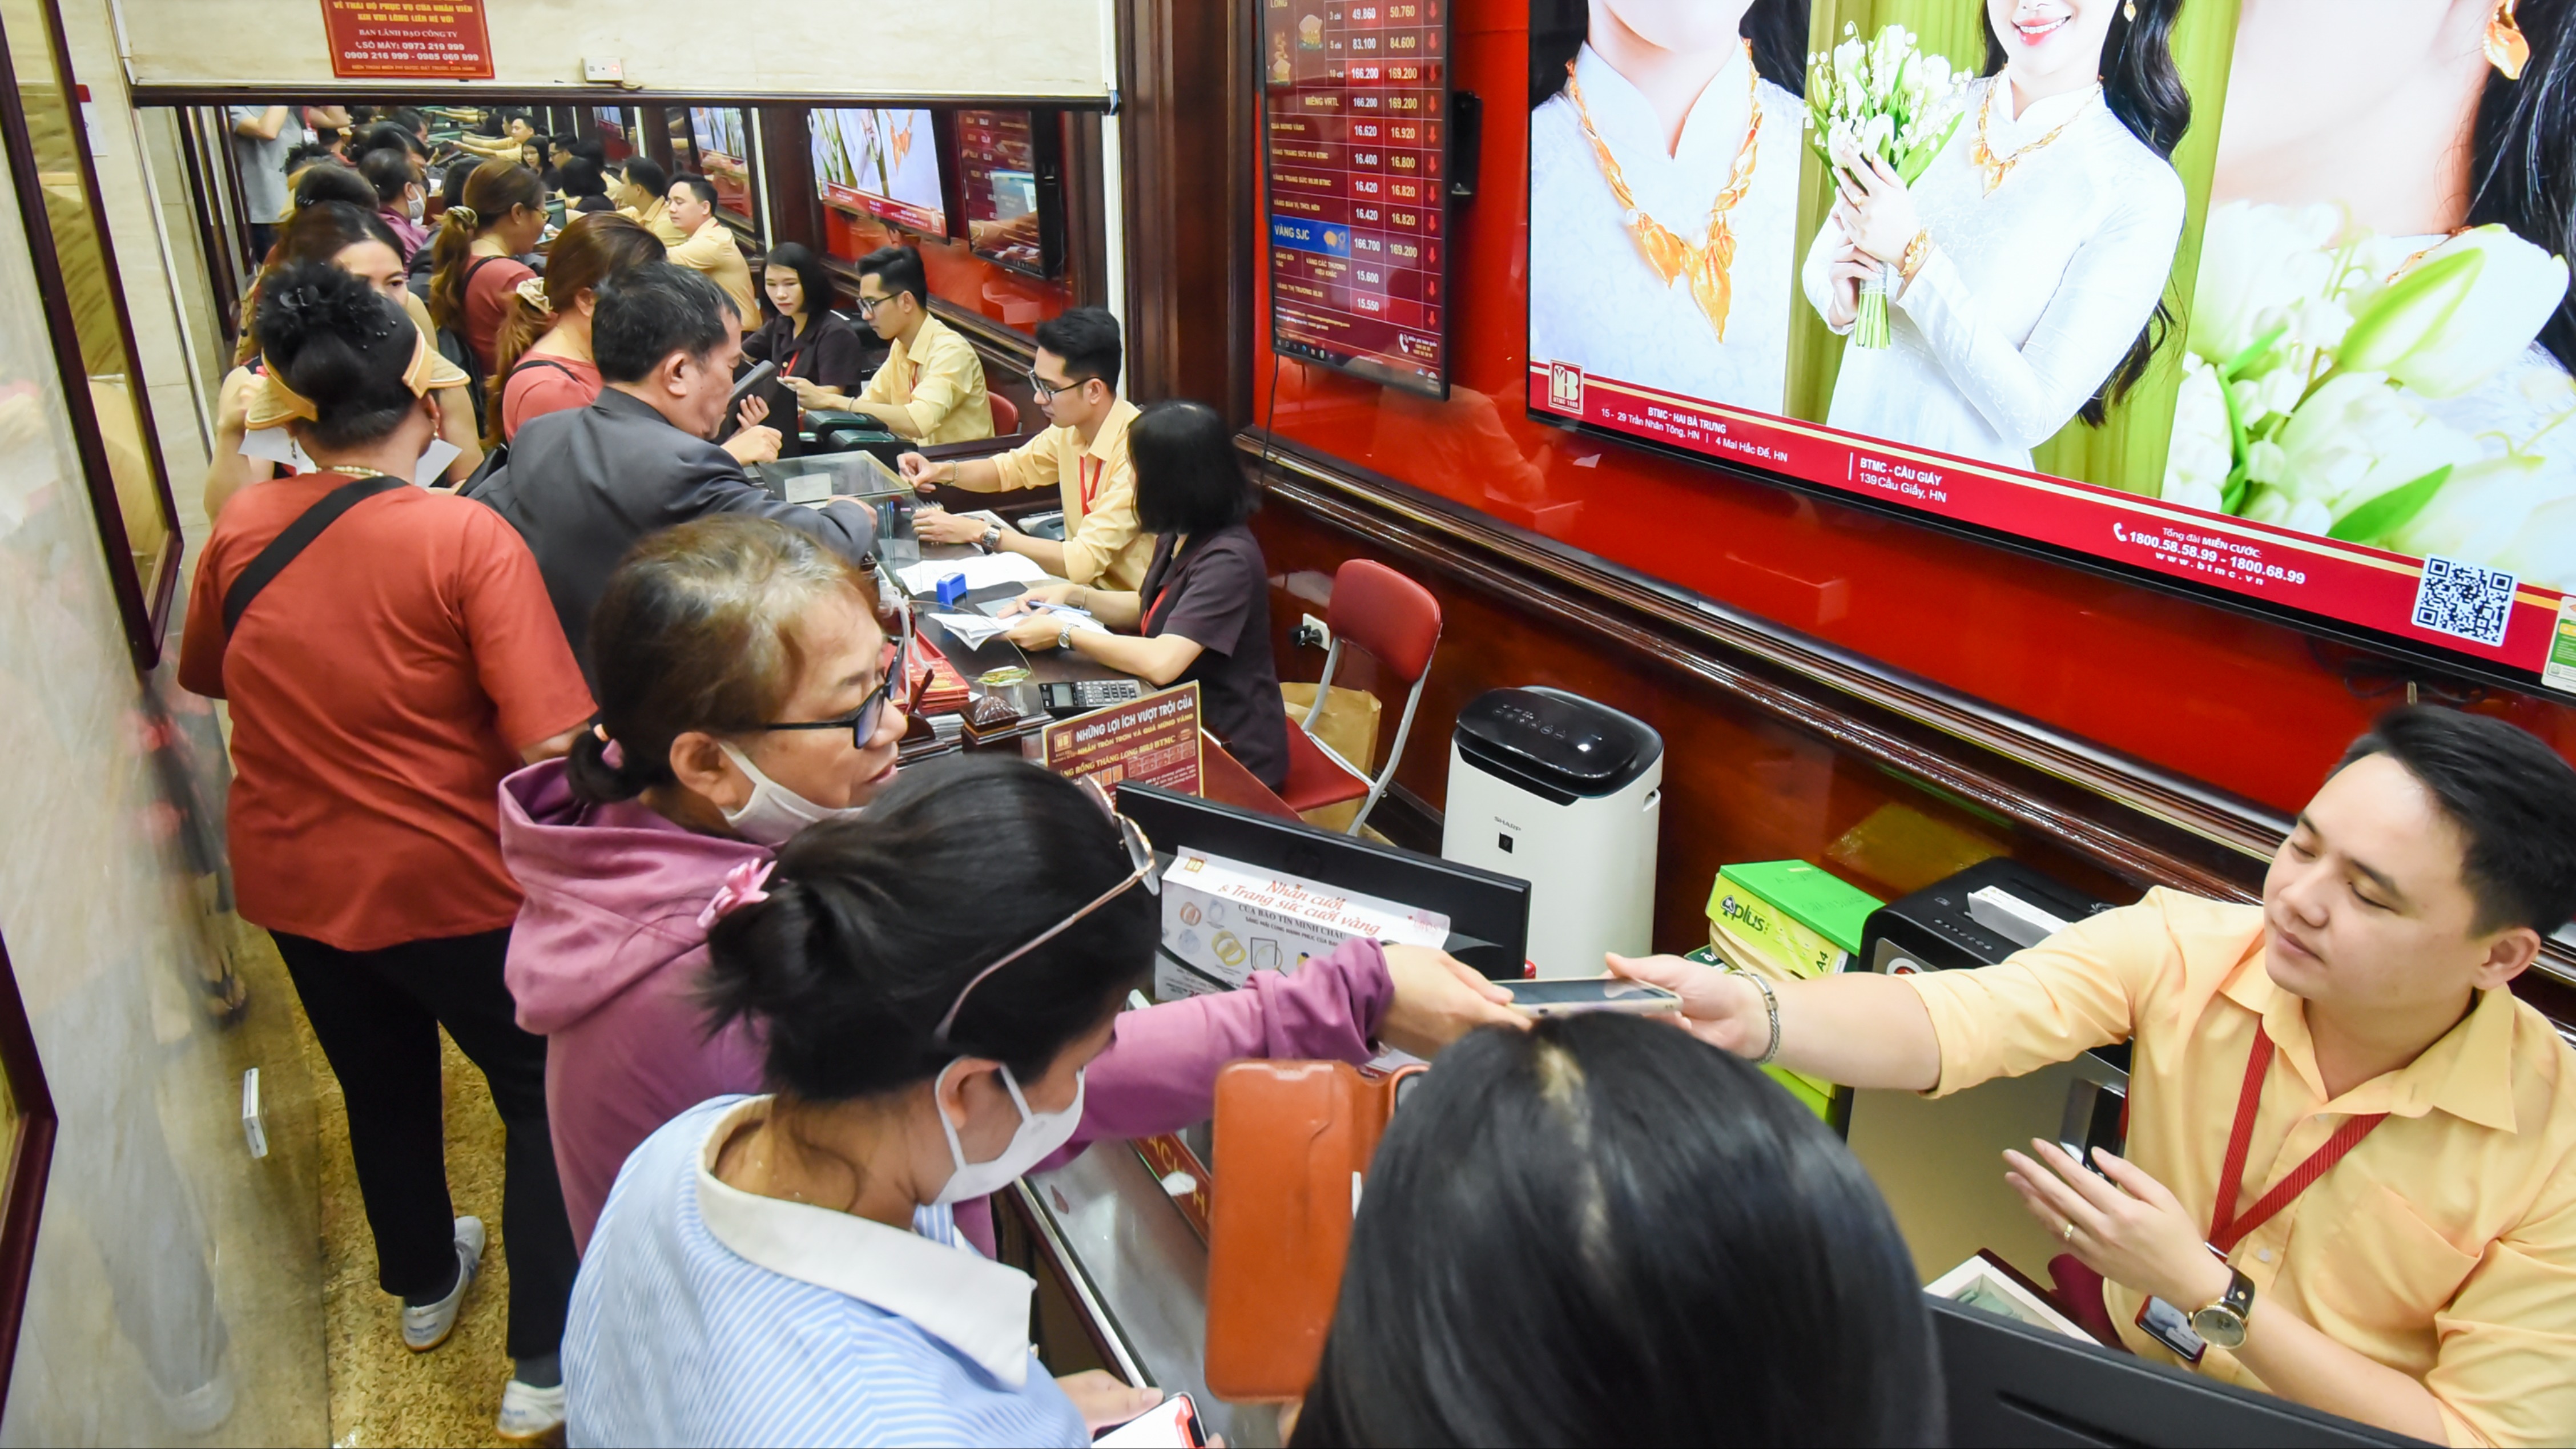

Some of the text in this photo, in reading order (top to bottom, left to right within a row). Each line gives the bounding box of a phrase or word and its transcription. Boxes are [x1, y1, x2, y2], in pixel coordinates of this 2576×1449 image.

[1352, 7, 1376, 19] 49.860
[1390, 5, 1415, 18] 50.760
[1353, 38, 1376, 50] 83.100
[1390, 37, 1415, 49] 84.600
[1351, 67, 1379, 79] 166.200
[1388, 67, 1418, 79] 169.200
[1324, 97, 1339, 106] VRTL
[1354, 98, 1378, 107] 166.200
[1388, 97, 1418, 109] 169.200
[1354, 125, 1377, 136] 16.620
[1391, 127, 1415, 139] 16.920
[1355, 153, 1378, 165] 16.400
[1391, 156, 1415, 168] 16.800
[1355, 180, 1378, 193] 16.420
[1391, 184, 1415, 197] 16.820
[1356, 208, 1378, 221] 16.420
[1391, 212, 1415, 226] 16.820
[1274, 223, 1418, 257] VÀNG SJC 166.700 169.200
[1357, 269, 1379, 284] 15.600
[1357, 297, 1379, 312] 15.550
[1648, 406, 1668, 420] BTMC
[1673, 413, 1686, 424] HAI
[1687, 414, 1698, 427] BÀ
[1700, 419, 1726, 434] TRƯNG
[1601, 408, 1610, 417] 15
[1617, 412, 1627, 422] 29
[1628, 414, 1644, 426] Trần
[1645, 418, 1664, 432] Nhân
[1688, 430, 1700, 440] HN
[1722, 438, 1737, 449] Mai
[1739, 441, 1756, 454] Hắc
[1773, 450, 1788, 462] HN
[1860, 457, 1887, 473] BTMC
[1894, 465, 1915, 480] CẦU
[1917, 472, 1942, 486] GIẤY
[1859, 472, 1946, 502] 139 Cầu Giấy, HN
[2163, 527, 2185, 542] Tổng
[2186, 533, 2200, 543] đài
[2202, 537, 2228, 550] MIỄN
[2130, 531, 2217, 562] 1800.58.58.99
[2230, 556, 2305, 584] 1800.68.99
[1076, 694, 1193, 742] NHỮNG LỢI ÍCH VƯỢT TRỘI CỦA
[1143, 724, 1156, 734] QUÀ
[1177, 713, 1194, 723] VÀNG
[1120, 747, 1138, 759] LONG
[1154, 735, 1176, 748] BTMC
[1494, 816, 1522, 831] SHARP
[1266, 880, 1308, 901] Nhẫn
[1231, 884, 1274, 906] Trang
[1275, 900, 1303, 913] sức
[1304, 907, 1341, 923] cưới
[1342, 917, 1382, 936] vàng
[1295, 920, 1318, 932] MINH
[1816, 951, 1828, 972] A4
